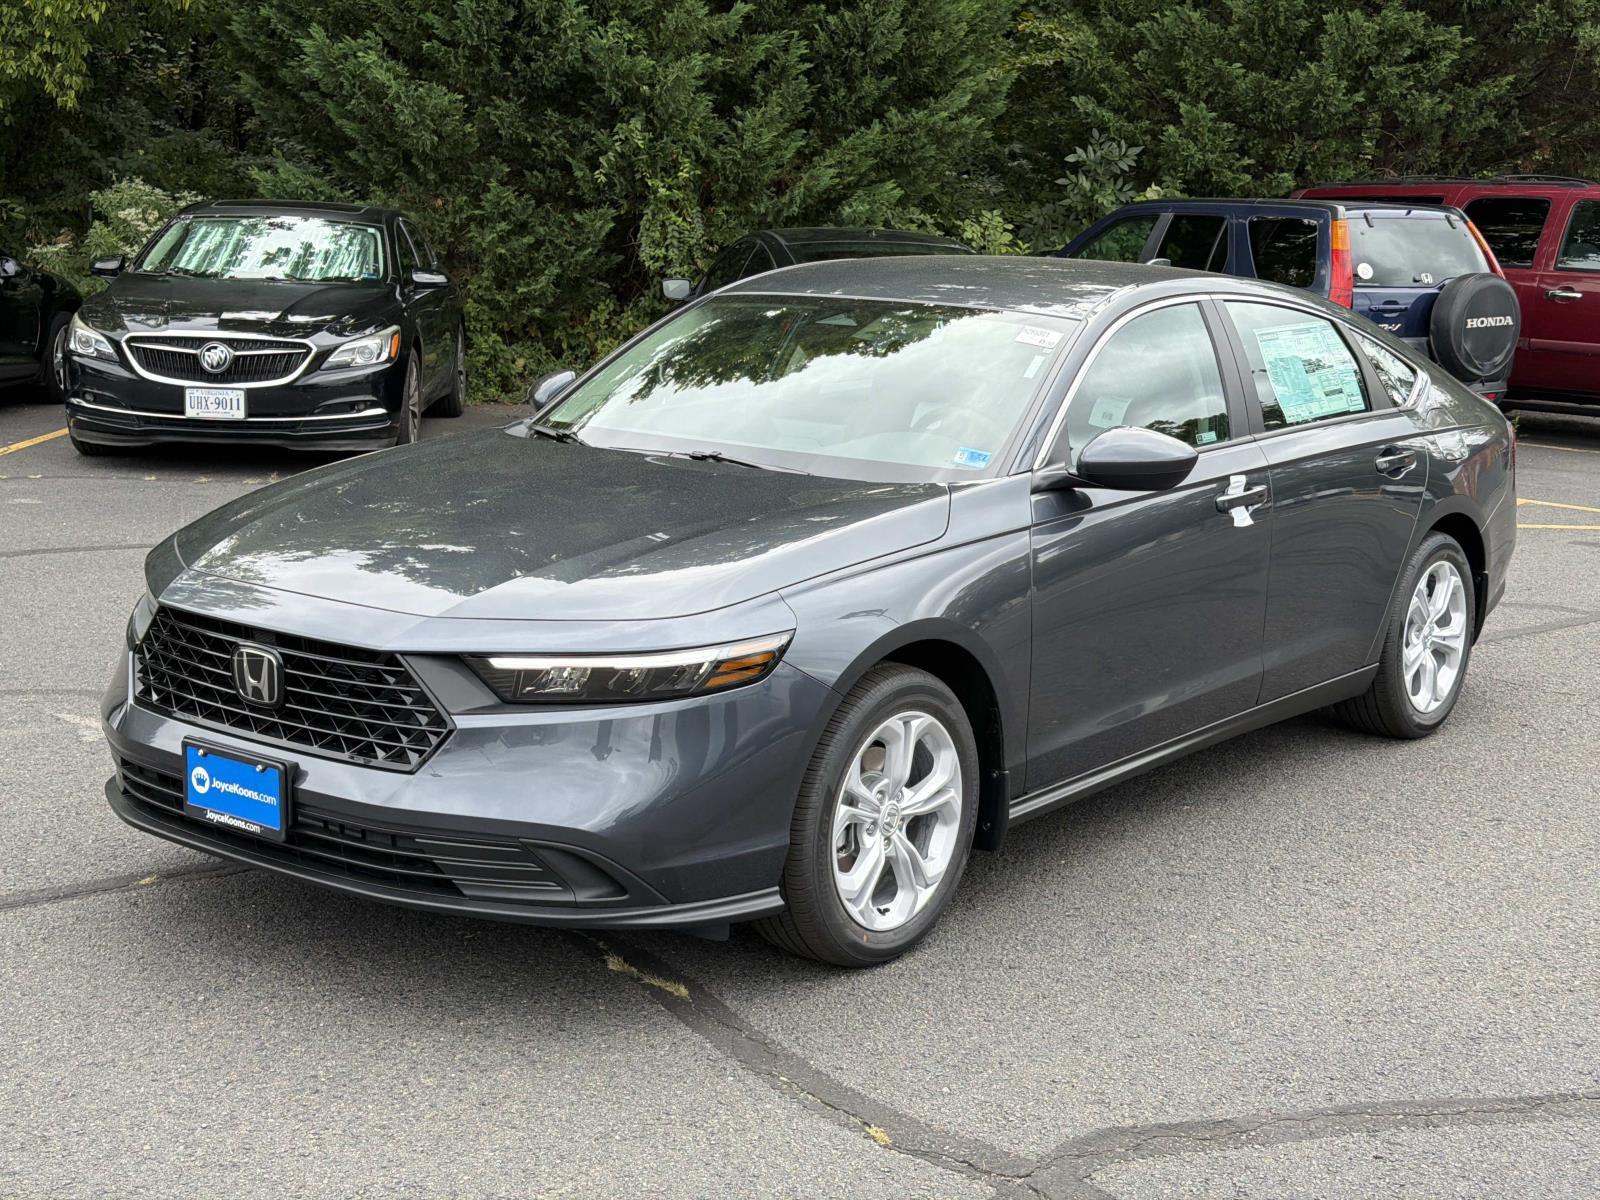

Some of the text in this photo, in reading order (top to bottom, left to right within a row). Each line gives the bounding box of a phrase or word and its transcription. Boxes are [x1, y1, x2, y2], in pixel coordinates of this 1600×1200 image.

[1466, 316, 1513, 329] HONDA
[211, 777, 277, 806] JoyceKoons.com
[206, 809, 261, 834] JoyceKoons.com
